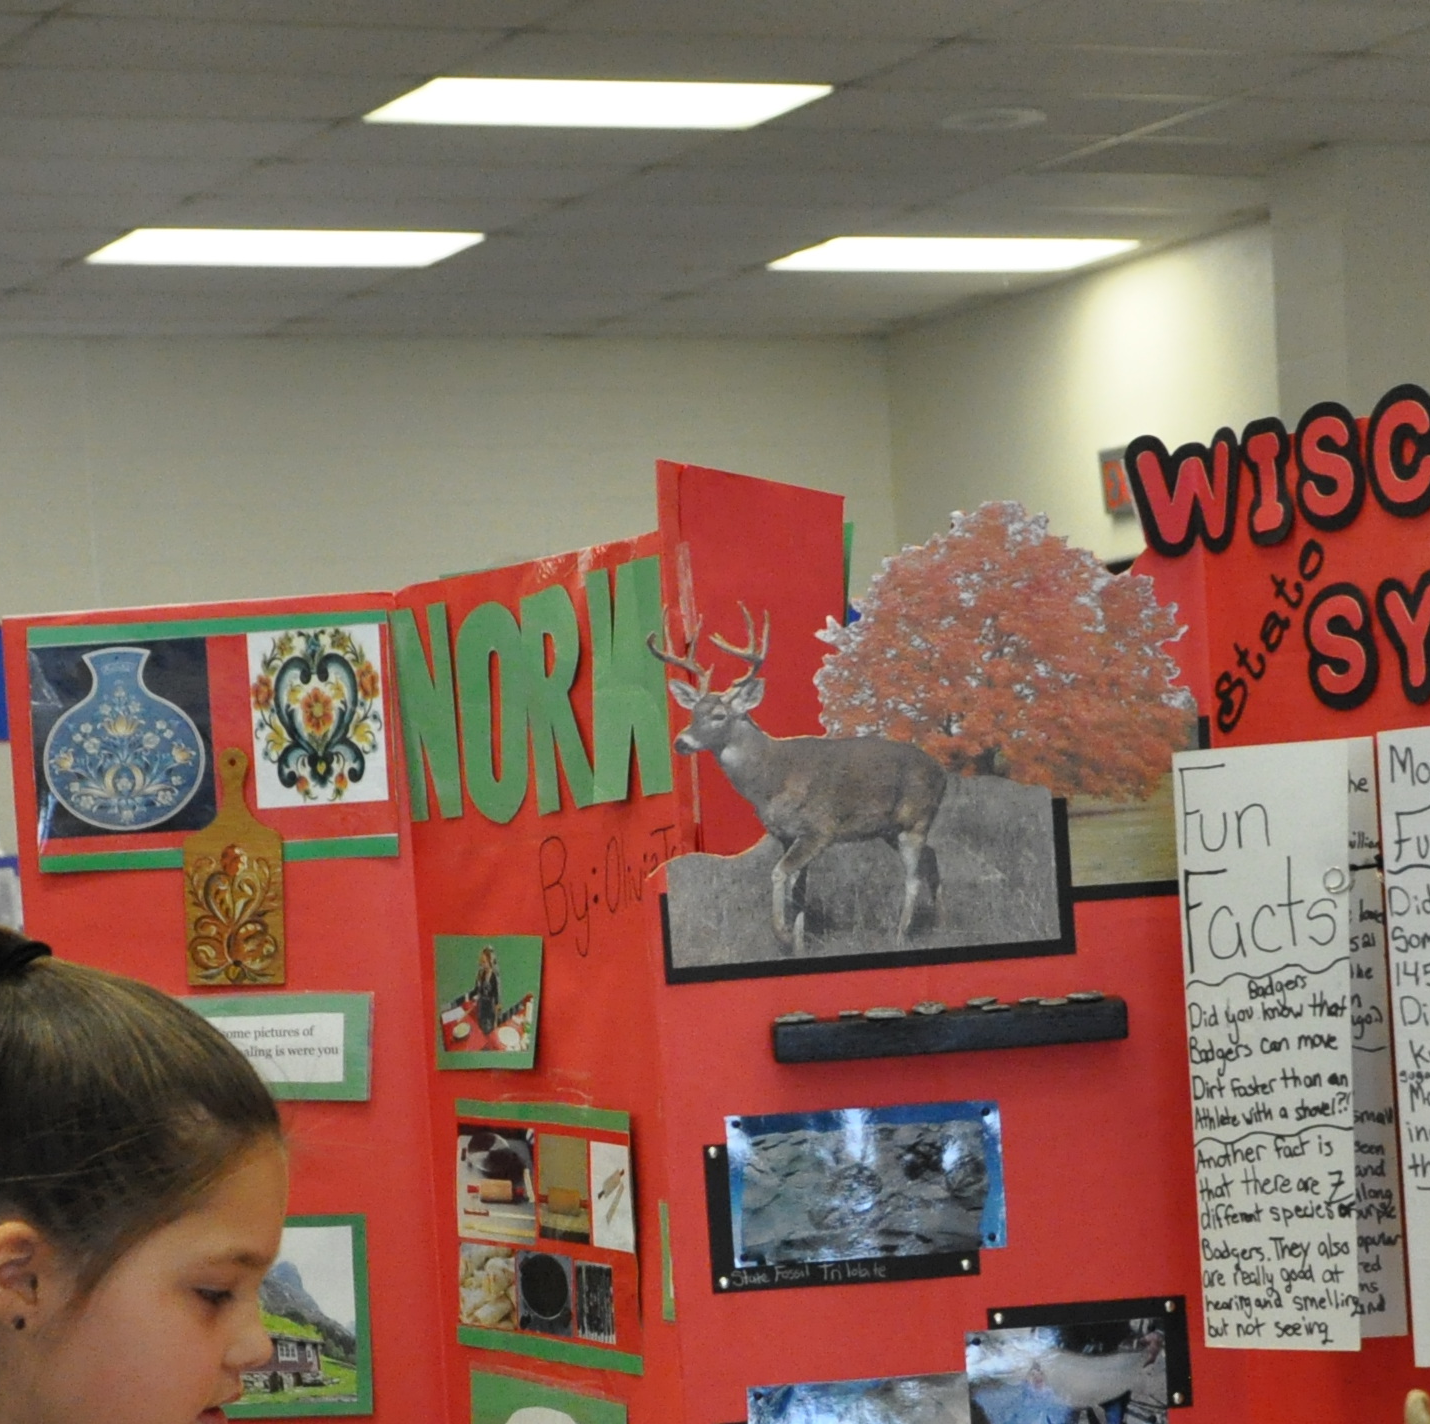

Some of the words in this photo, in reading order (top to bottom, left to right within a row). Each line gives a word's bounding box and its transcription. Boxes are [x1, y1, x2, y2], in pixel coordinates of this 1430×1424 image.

[1178, 763, 1271, 856] Fun
[1183, 855, 1338, 975] Facts
[1247, 974, 1308, 1006] Badgers
[254, 1026, 300, 1041] pictures
[302, 1025, 316, 1038] of
[1188, 1002, 1219, 1030] Did
[1225, 1005, 1254, 1045] you
[1261, 1000, 1303, 1022] know
[1308, 991, 1347, 1018] that
[275, 1046, 285, 1057] is
[287, 1046, 315, 1057] were
[317, 1046, 339, 1059] you
[1189, 1036, 1253, 1077] Badgers
[1260, 1037, 1290, 1055] can
[1297, 1033, 1339, 1051] move
[1192, 1075, 1226, 1101] Dirt
[1280, 1067, 1322, 1089] than
[1242, 1101, 1273, 1126] with
[1278, 1109, 1289, 1120] a
[1195, 1142, 1267, 1174] Another
[1317, 1134, 1334, 1157] is
[1199, 1172, 1234, 1201] that
[1241, 1165, 1292, 1196] there
[1296, 1176, 1320, 1196] are
[1270, 1200, 1335, 1227] species
[1269, 1236, 1311, 1271] They
[1317, 1232, 1351, 1257] also
[1203, 1271, 1226, 1289] are
[1233, 1265, 1276, 1298] really
[1280, 1264, 1316, 1294] good
[1322, 1268, 1345, 1285] at
[1254, 1289, 1283, 1310] and
[1207, 1316, 1230, 1338] but
[1236, 1317, 1266, 1337] not
[1275, 1315, 1334, 1345] seeing
